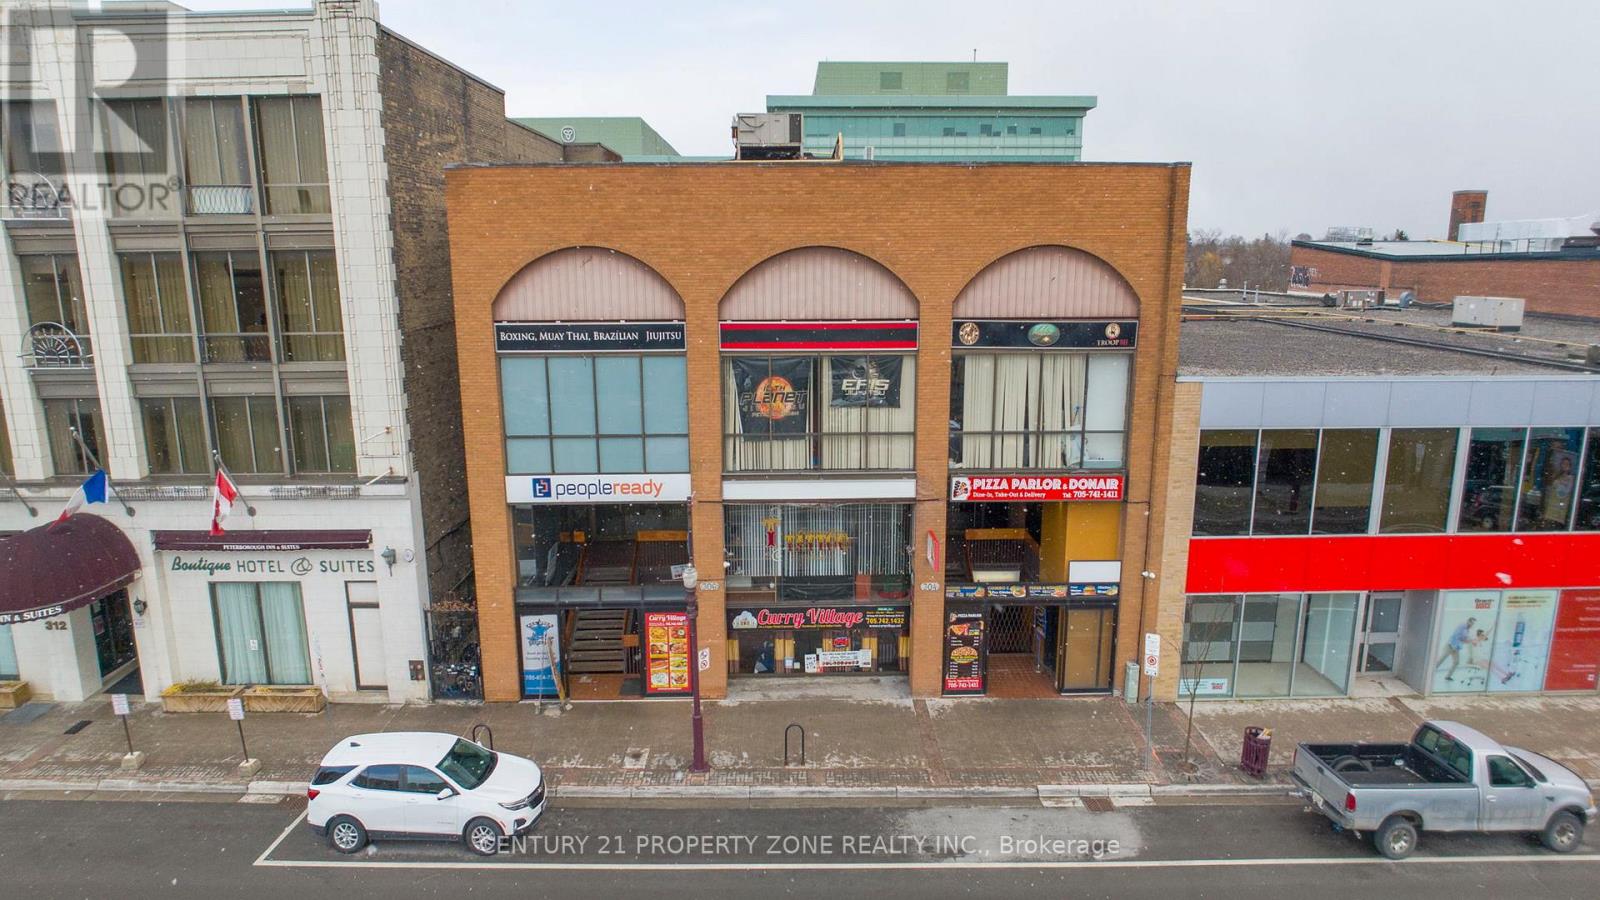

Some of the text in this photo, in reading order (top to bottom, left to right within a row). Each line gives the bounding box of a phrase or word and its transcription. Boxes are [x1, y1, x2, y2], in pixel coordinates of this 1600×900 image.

[500, 330, 681, 342] BOXING, MUAY THAI, BRAZILIAN JIUJITSU
[556, 478, 664, 500] peopleready
[973, 478, 1010, 490] PIZZA
[1012, 478, 1062, 490] PARLOR
[1069, 478, 1119, 491] DONAIR
[1024, 491, 1046, 499] Delivery
[1073, 490, 1118, 498] 705-741-1411
[171, 556, 232, 576] Boutique
[237, 560, 285, 573] HOTEL
[319, 560, 375, 573] SUITES
[14, 614, 21, 622] &
[23, 605, 63, 620] SUITES
[757, 608, 863, 629] Curry Village
[45, 621, 67, 631] 312
